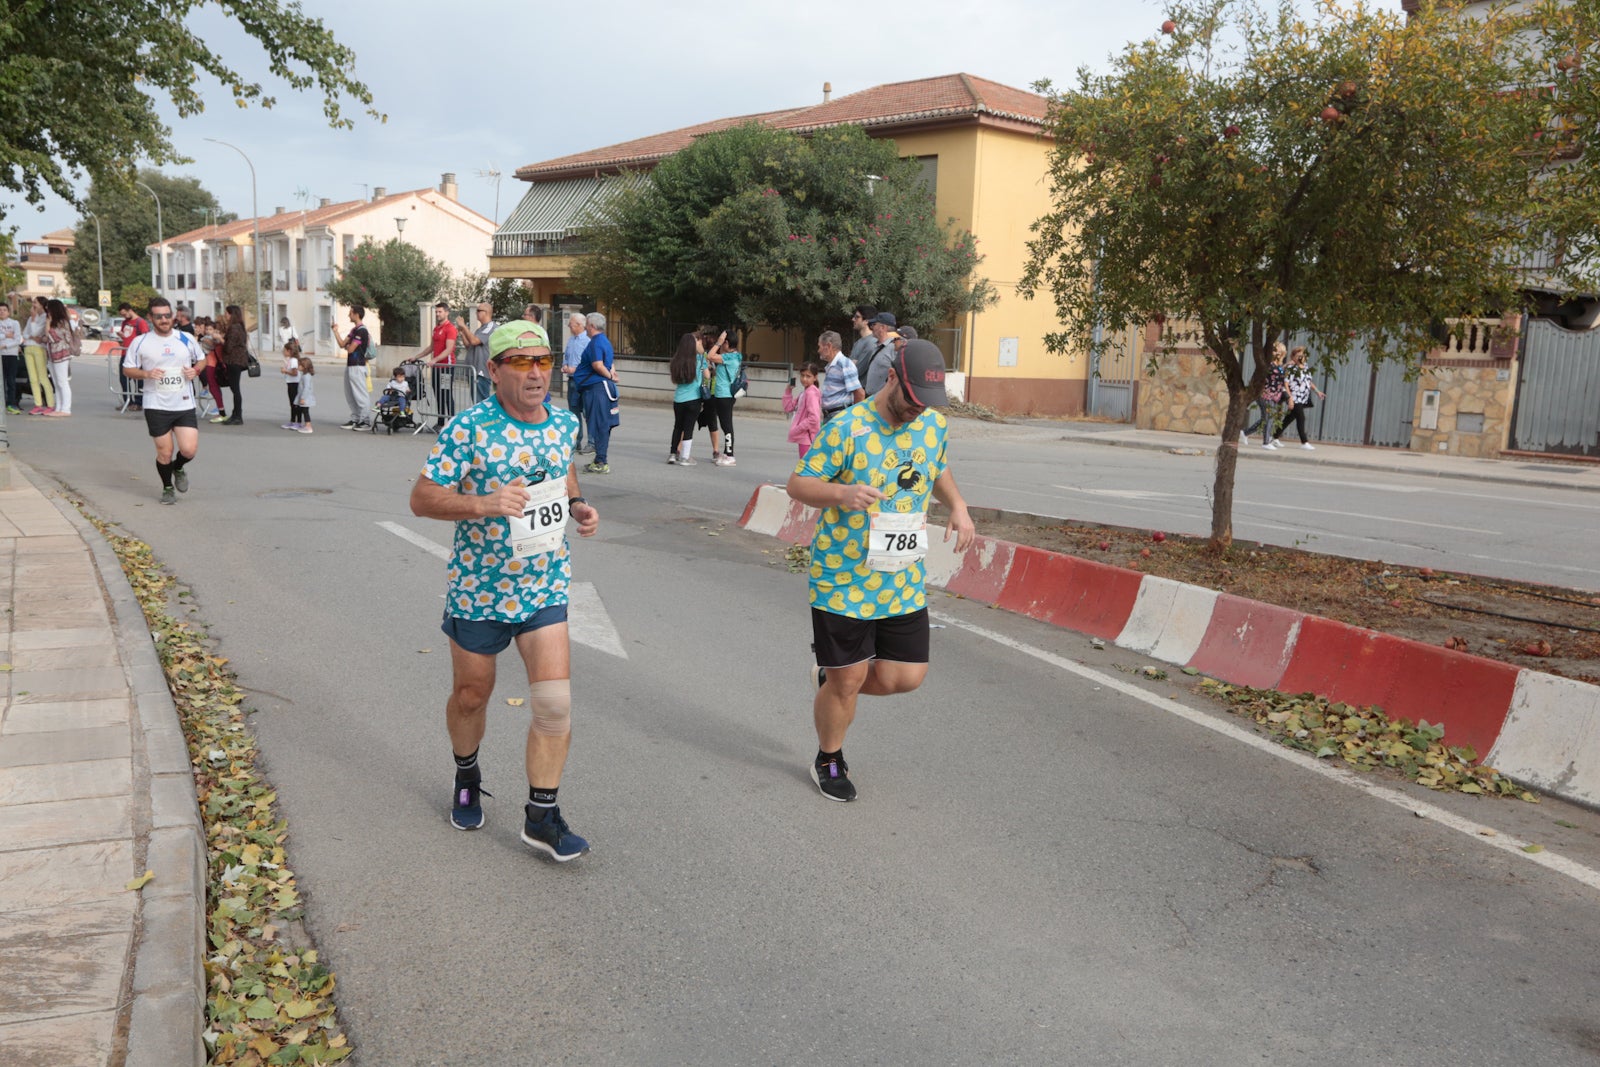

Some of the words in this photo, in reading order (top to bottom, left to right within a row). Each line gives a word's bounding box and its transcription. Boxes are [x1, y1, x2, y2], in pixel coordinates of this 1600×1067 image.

[159, 376, 182, 385] 3029
[523, 502, 563, 531] 789
[885, 533, 917, 551] 788
